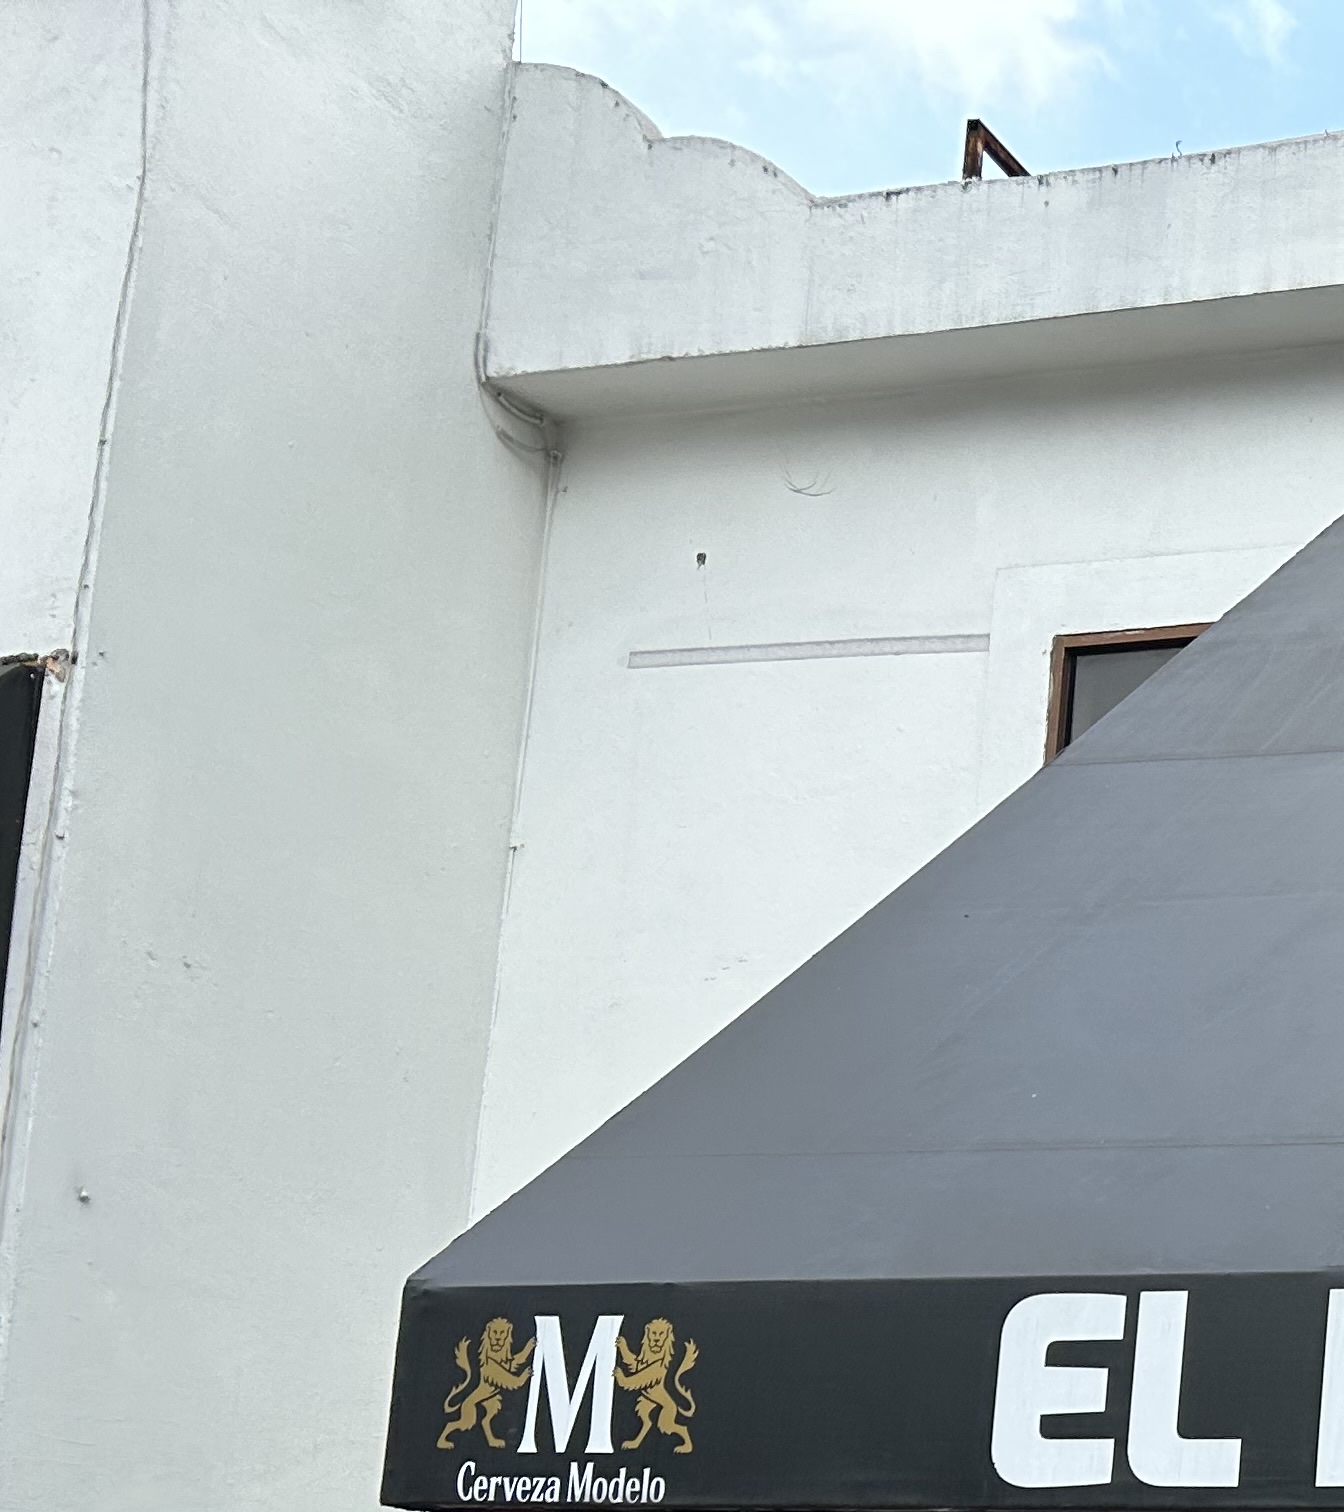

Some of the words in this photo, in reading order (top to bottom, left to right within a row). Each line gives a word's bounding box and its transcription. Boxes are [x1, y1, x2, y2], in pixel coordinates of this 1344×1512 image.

[516, 1314, 625, 1454] M
[990, 1290, 1242, 1489] EL
[456, 1460, 561, 1503] Cerveza
[566, 1461, 666, 1504] Modelo
